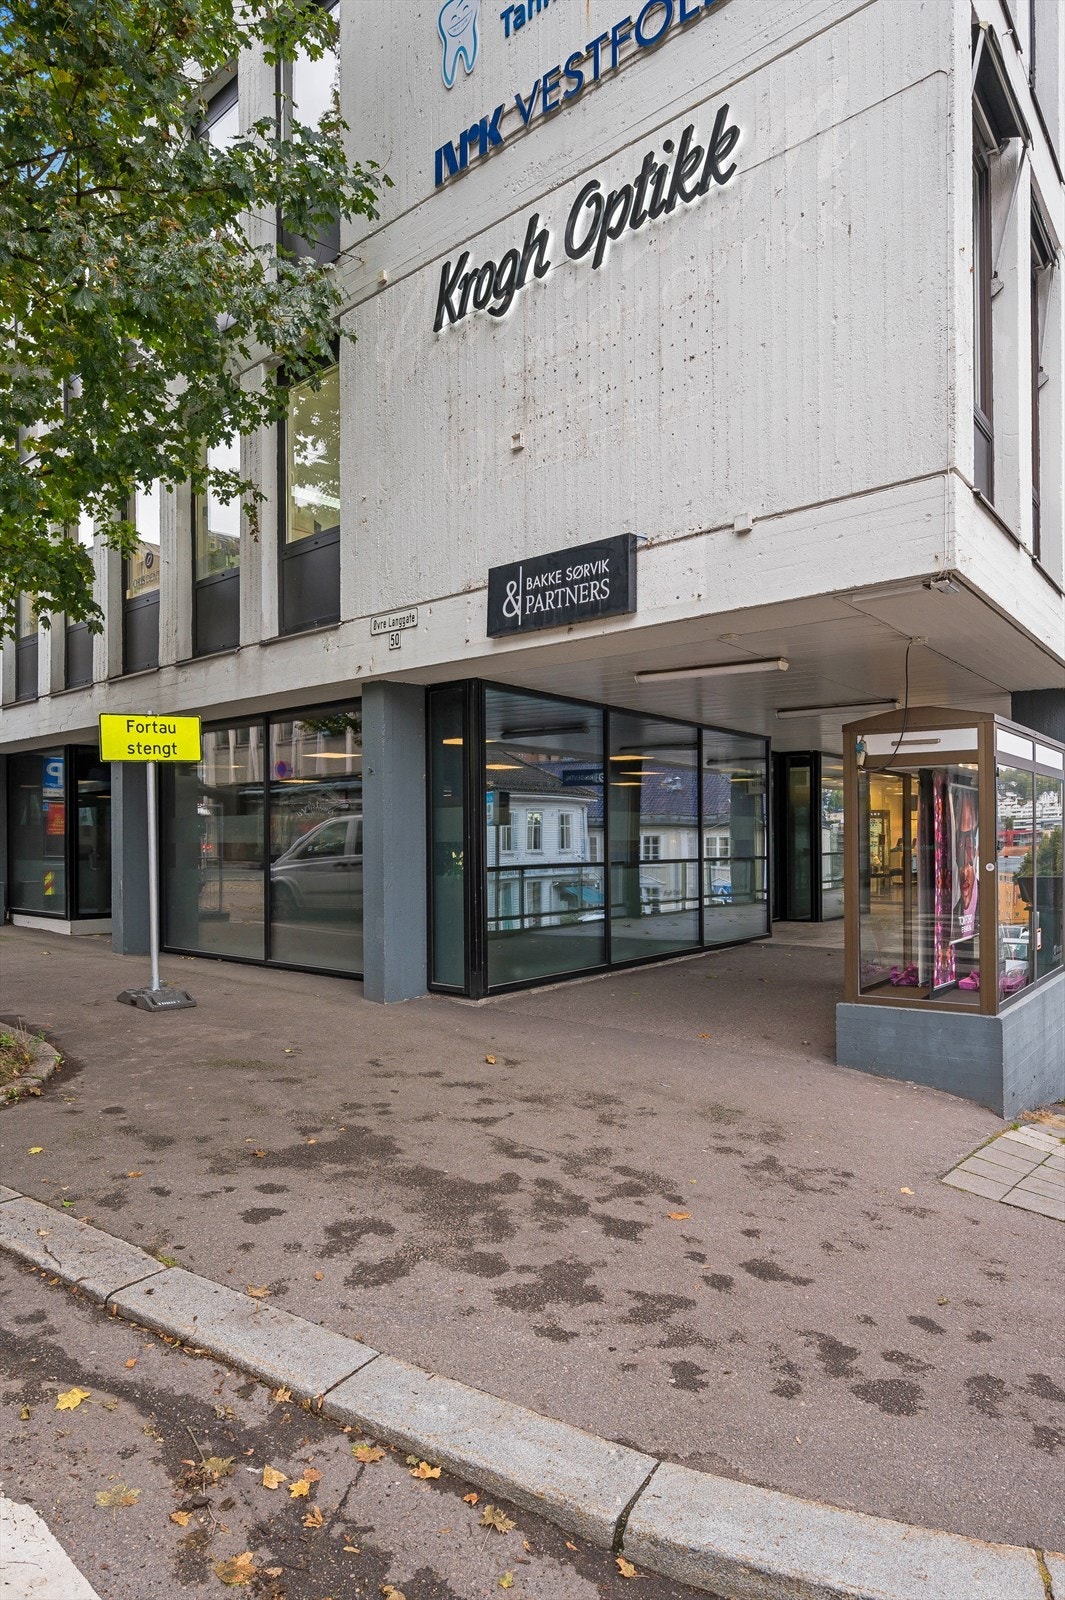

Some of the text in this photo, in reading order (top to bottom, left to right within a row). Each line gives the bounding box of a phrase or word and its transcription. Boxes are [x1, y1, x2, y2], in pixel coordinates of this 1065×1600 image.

[500, 0, 550, 38] Tan
[514, 0, 722, 127] VESTFOL
[433, 103, 740, 332] Krogh Optikk
[526, 558, 610, 590] BAKKE SØRVIK
[525, 578, 610, 615] PARTNERS
[373, 613, 415, 631] Øvre Langgate
[390, 633, 400, 647] 50
[126, 719, 176, 734] Fortau
[127, 742, 178, 758] stengt
